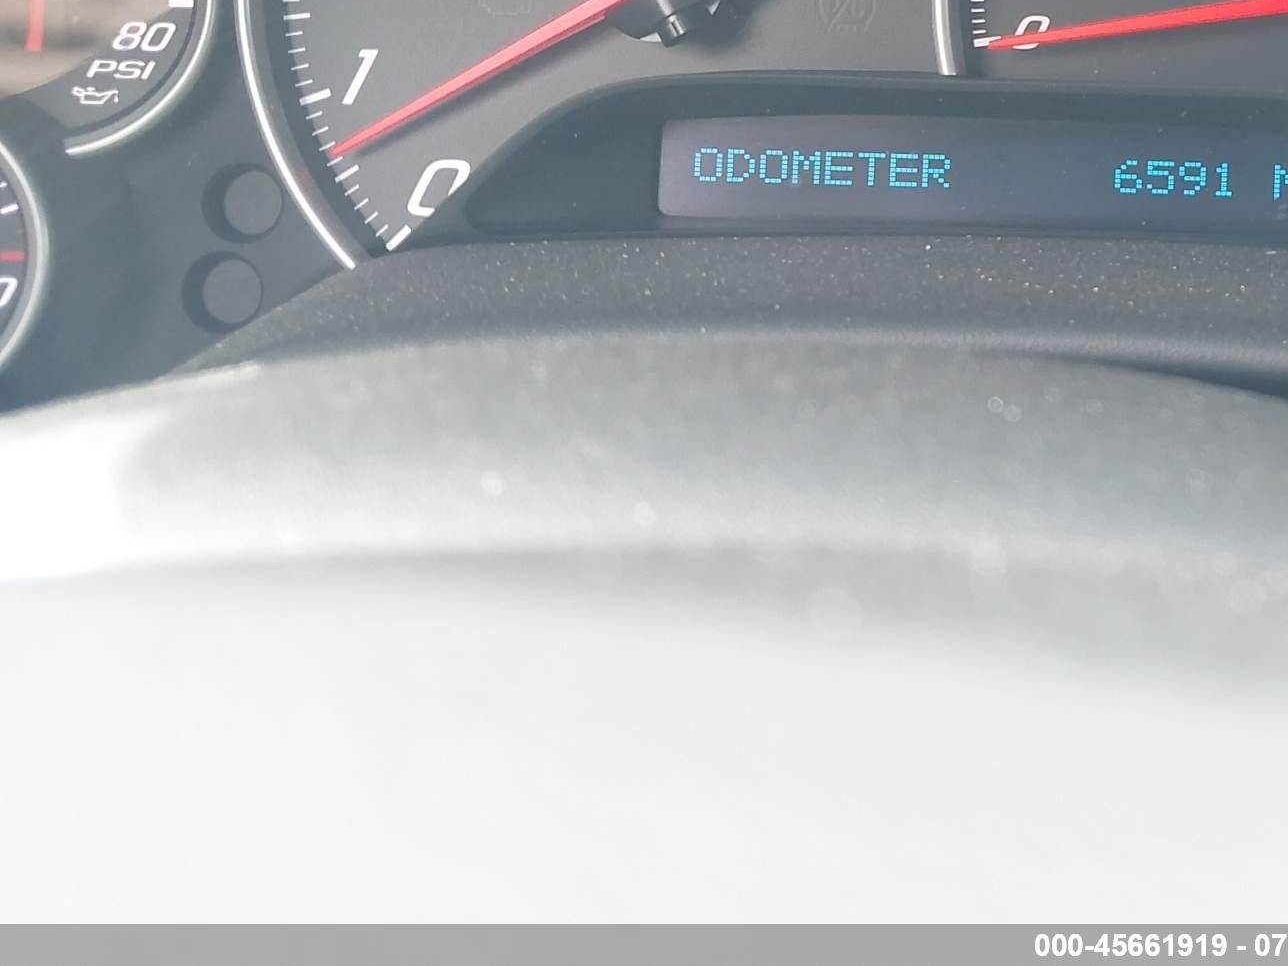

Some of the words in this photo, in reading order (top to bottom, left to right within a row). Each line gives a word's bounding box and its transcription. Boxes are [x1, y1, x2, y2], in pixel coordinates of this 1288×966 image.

[111, 20, 177, 52] 80
[1012, 15, 1051, 50] 0
[86, 59, 156, 80] PSI
[341, 48, 379, 106] 1
[406, 158, 472, 218] 0
[693, 147, 953, 190] ODOMETER
[1113, 158, 1233, 199] 6591
